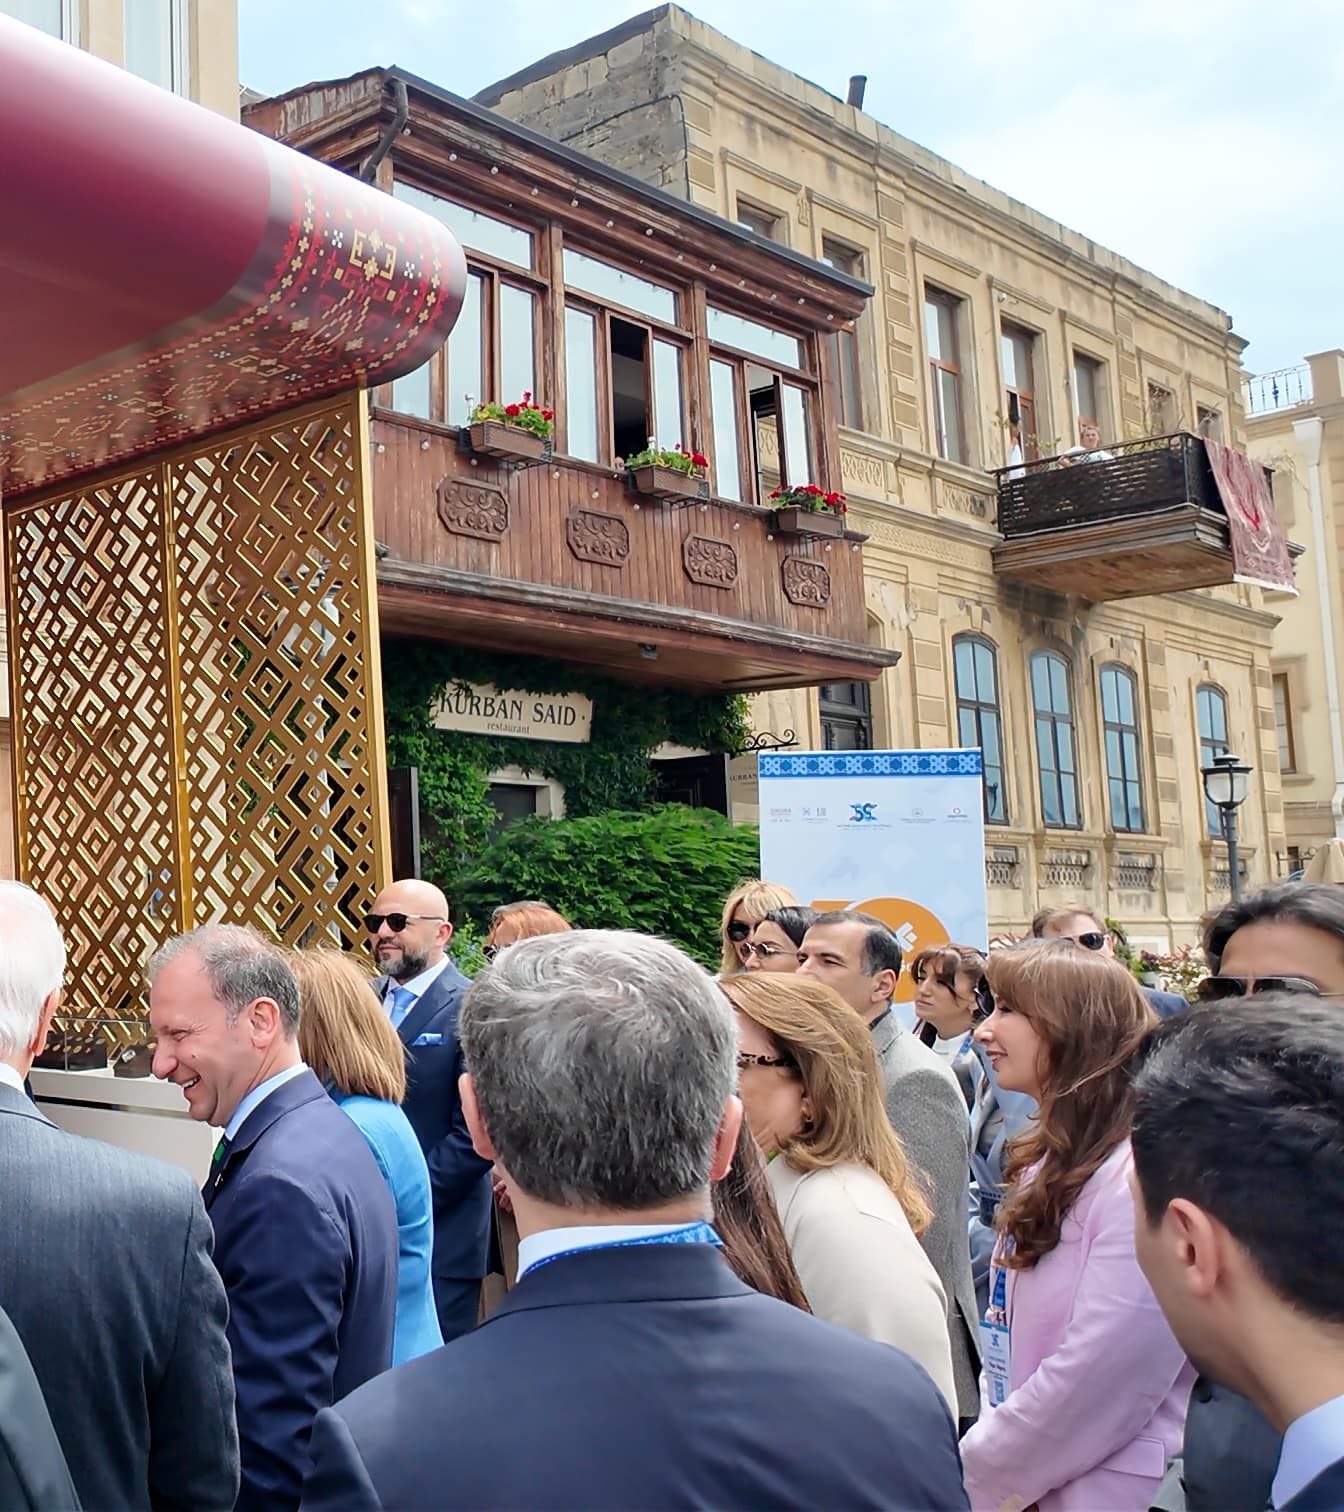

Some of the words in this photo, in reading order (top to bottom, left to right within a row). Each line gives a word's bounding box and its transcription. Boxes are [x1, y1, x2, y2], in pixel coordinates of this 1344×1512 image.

[440, 691, 523, 721] KURBAN
[531, 702, 576, 727] SAID
[487, 721, 530, 734] restaurant
